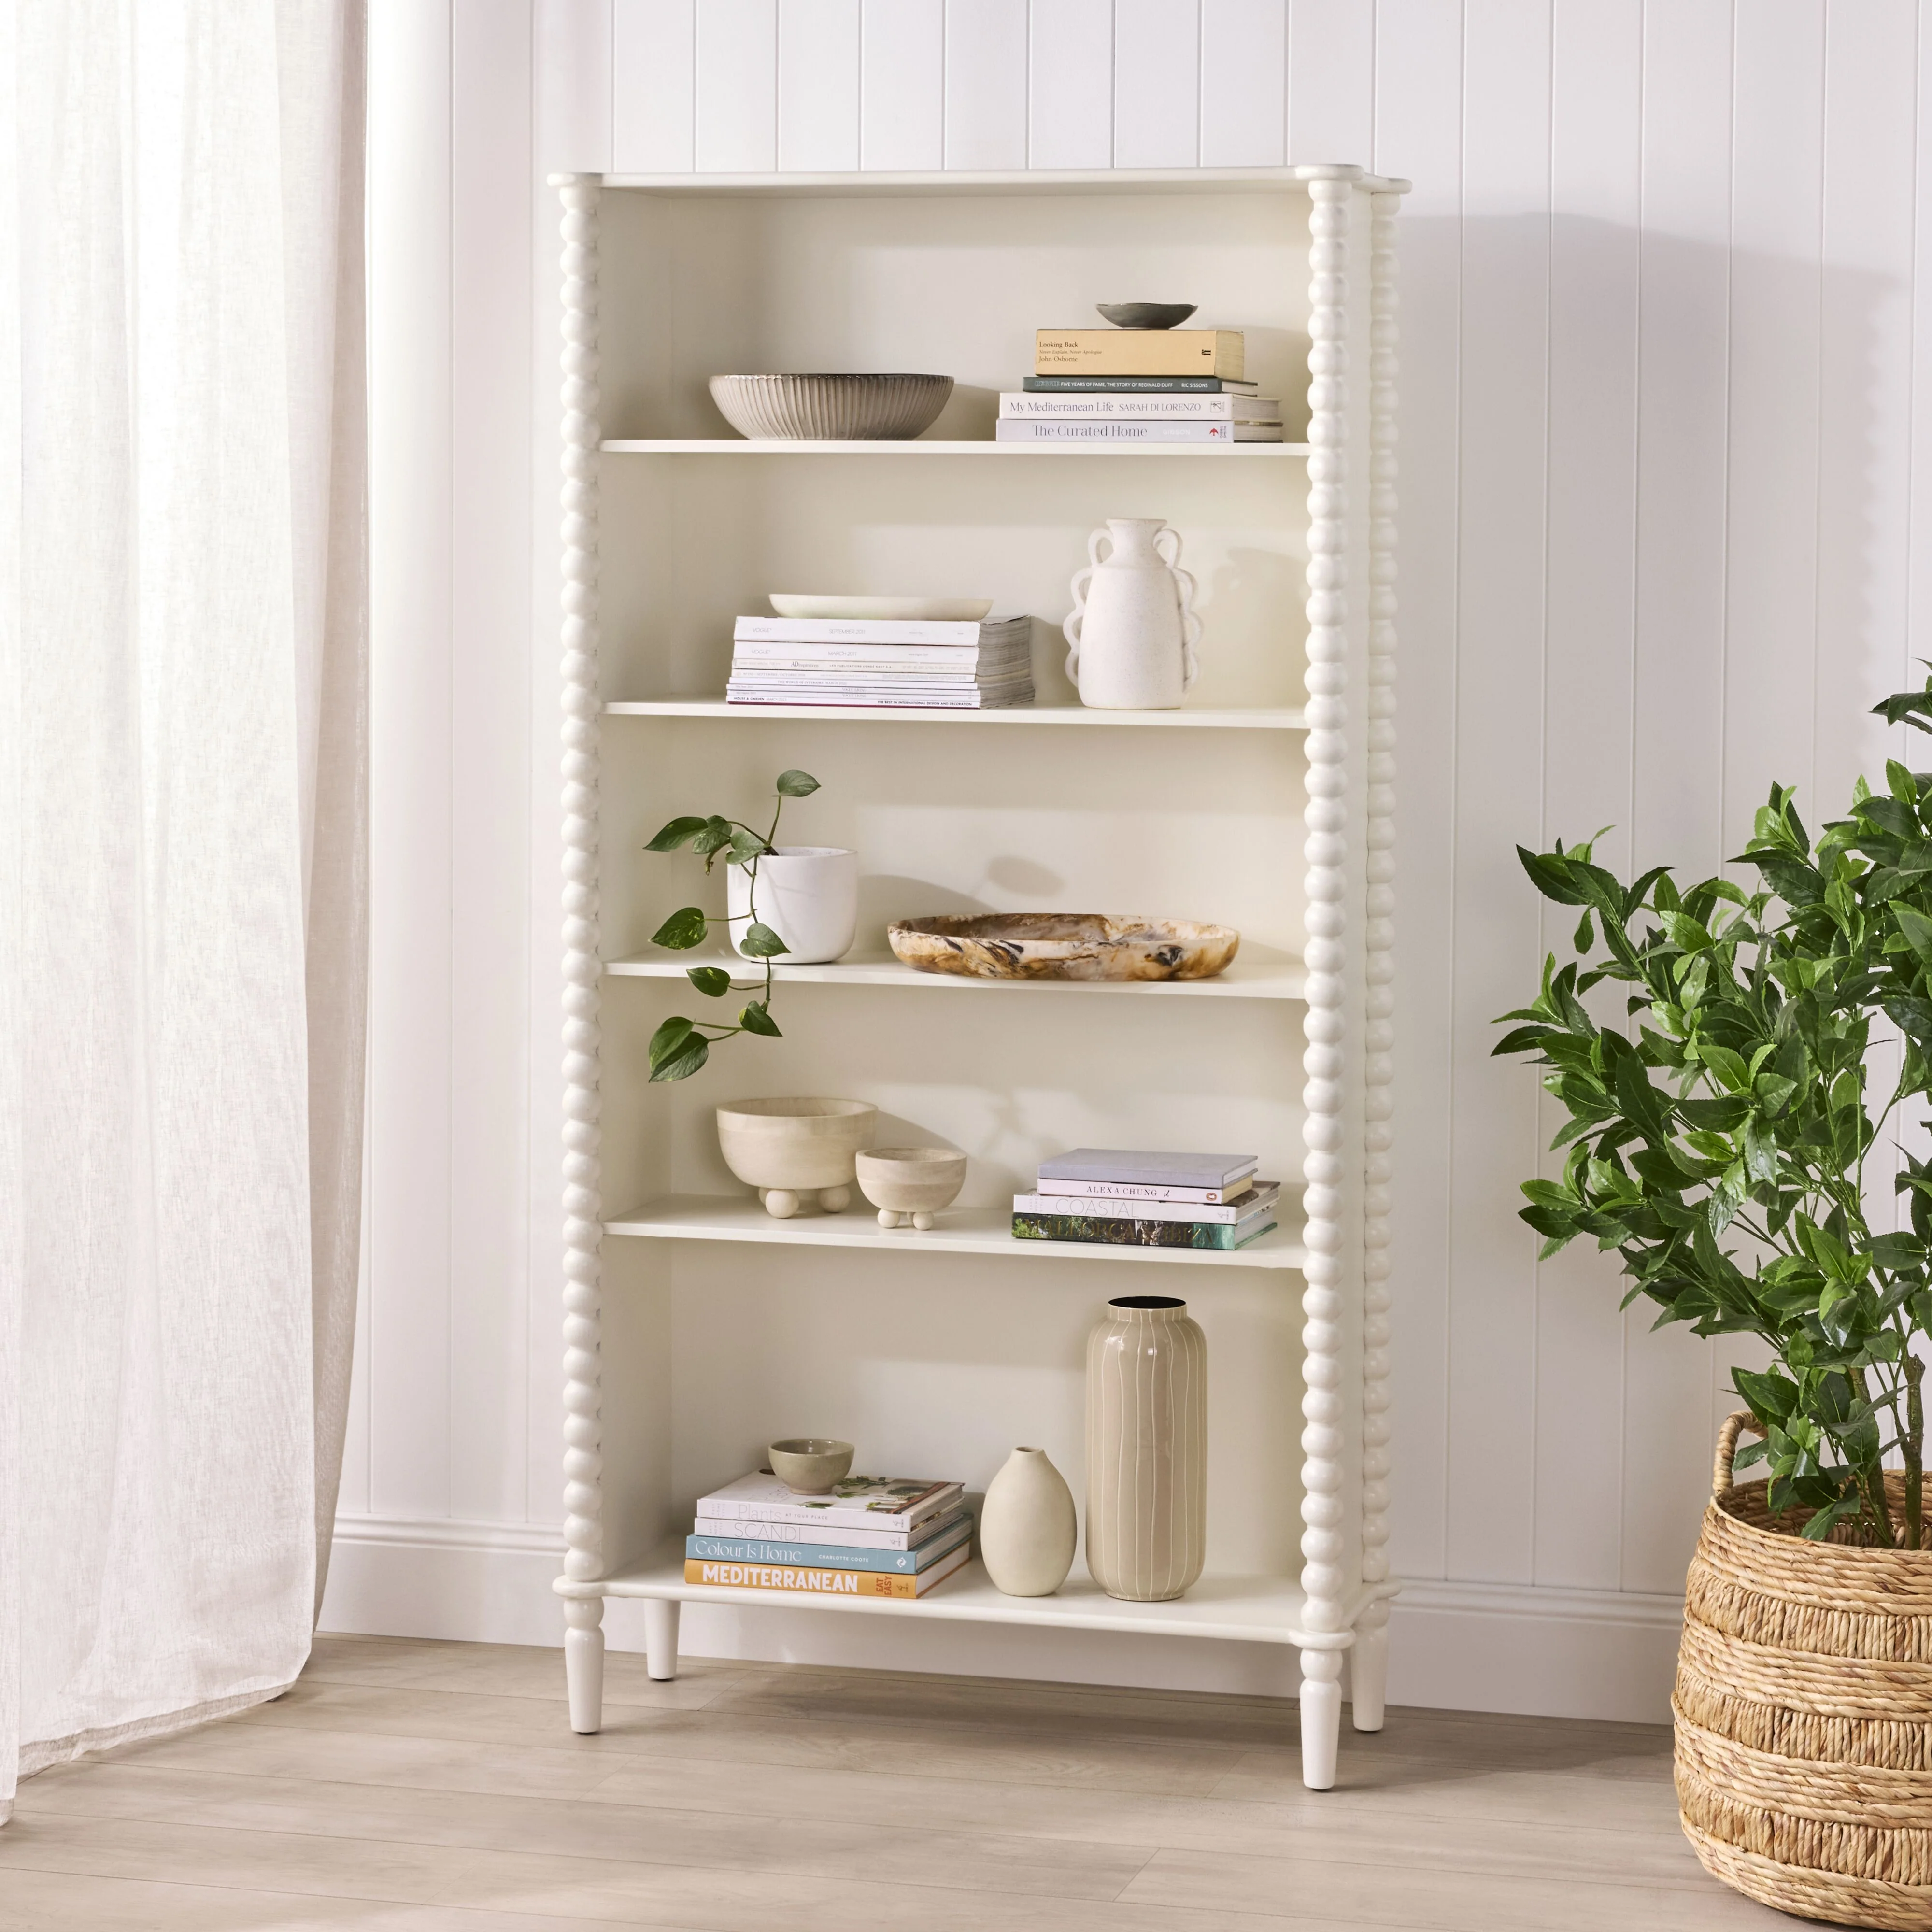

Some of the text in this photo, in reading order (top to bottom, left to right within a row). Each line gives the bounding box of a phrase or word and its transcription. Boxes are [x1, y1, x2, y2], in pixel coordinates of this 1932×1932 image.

[1010, 402, 1113, 413] My Mediterranean Life
[1119, 403, 1201, 412] SARAH DI LORENZO
[1032, 425, 1148, 437] The Curated Home
[1123, 1188, 1157, 1196] CHUNG
[1056, 1198, 1139, 1218] COASTAL
[1163, 1226, 1214, 1244] IBIZA
[738, 1504, 781, 1521] Plants
[734, 1522, 801, 1542] SCANDI
[695, 1540, 802, 1562] Colour Is Home
[702, 1564, 858, 1593] MEDITERRANEAN
[876, 1577, 884, 1592] EAT
[884, 1576, 893, 1595] EASY
